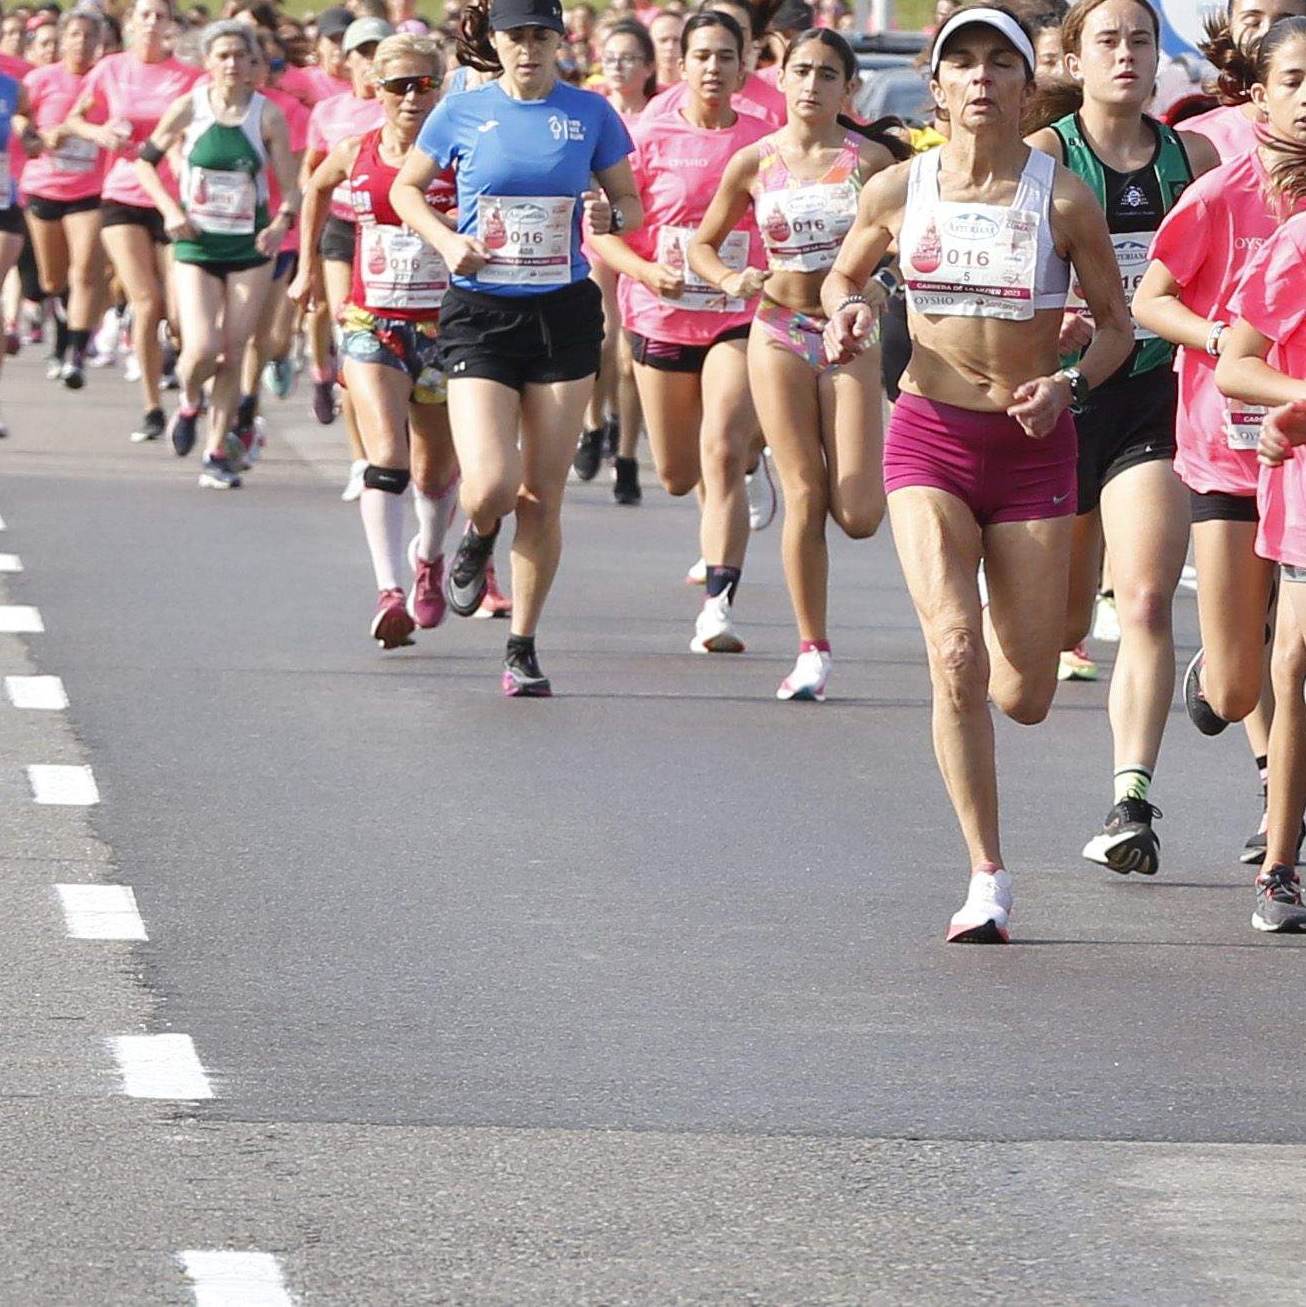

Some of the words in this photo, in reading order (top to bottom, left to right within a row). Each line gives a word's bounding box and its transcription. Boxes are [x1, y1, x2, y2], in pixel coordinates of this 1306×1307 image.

[793, 219, 825, 233] 016
[511, 231, 543, 244] 016
[947, 249, 990, 267] 016
[390, 259, 420, 271] 016
[963, 271, 971, 282] 5
[914, 296, 954, 306] OYSHO
